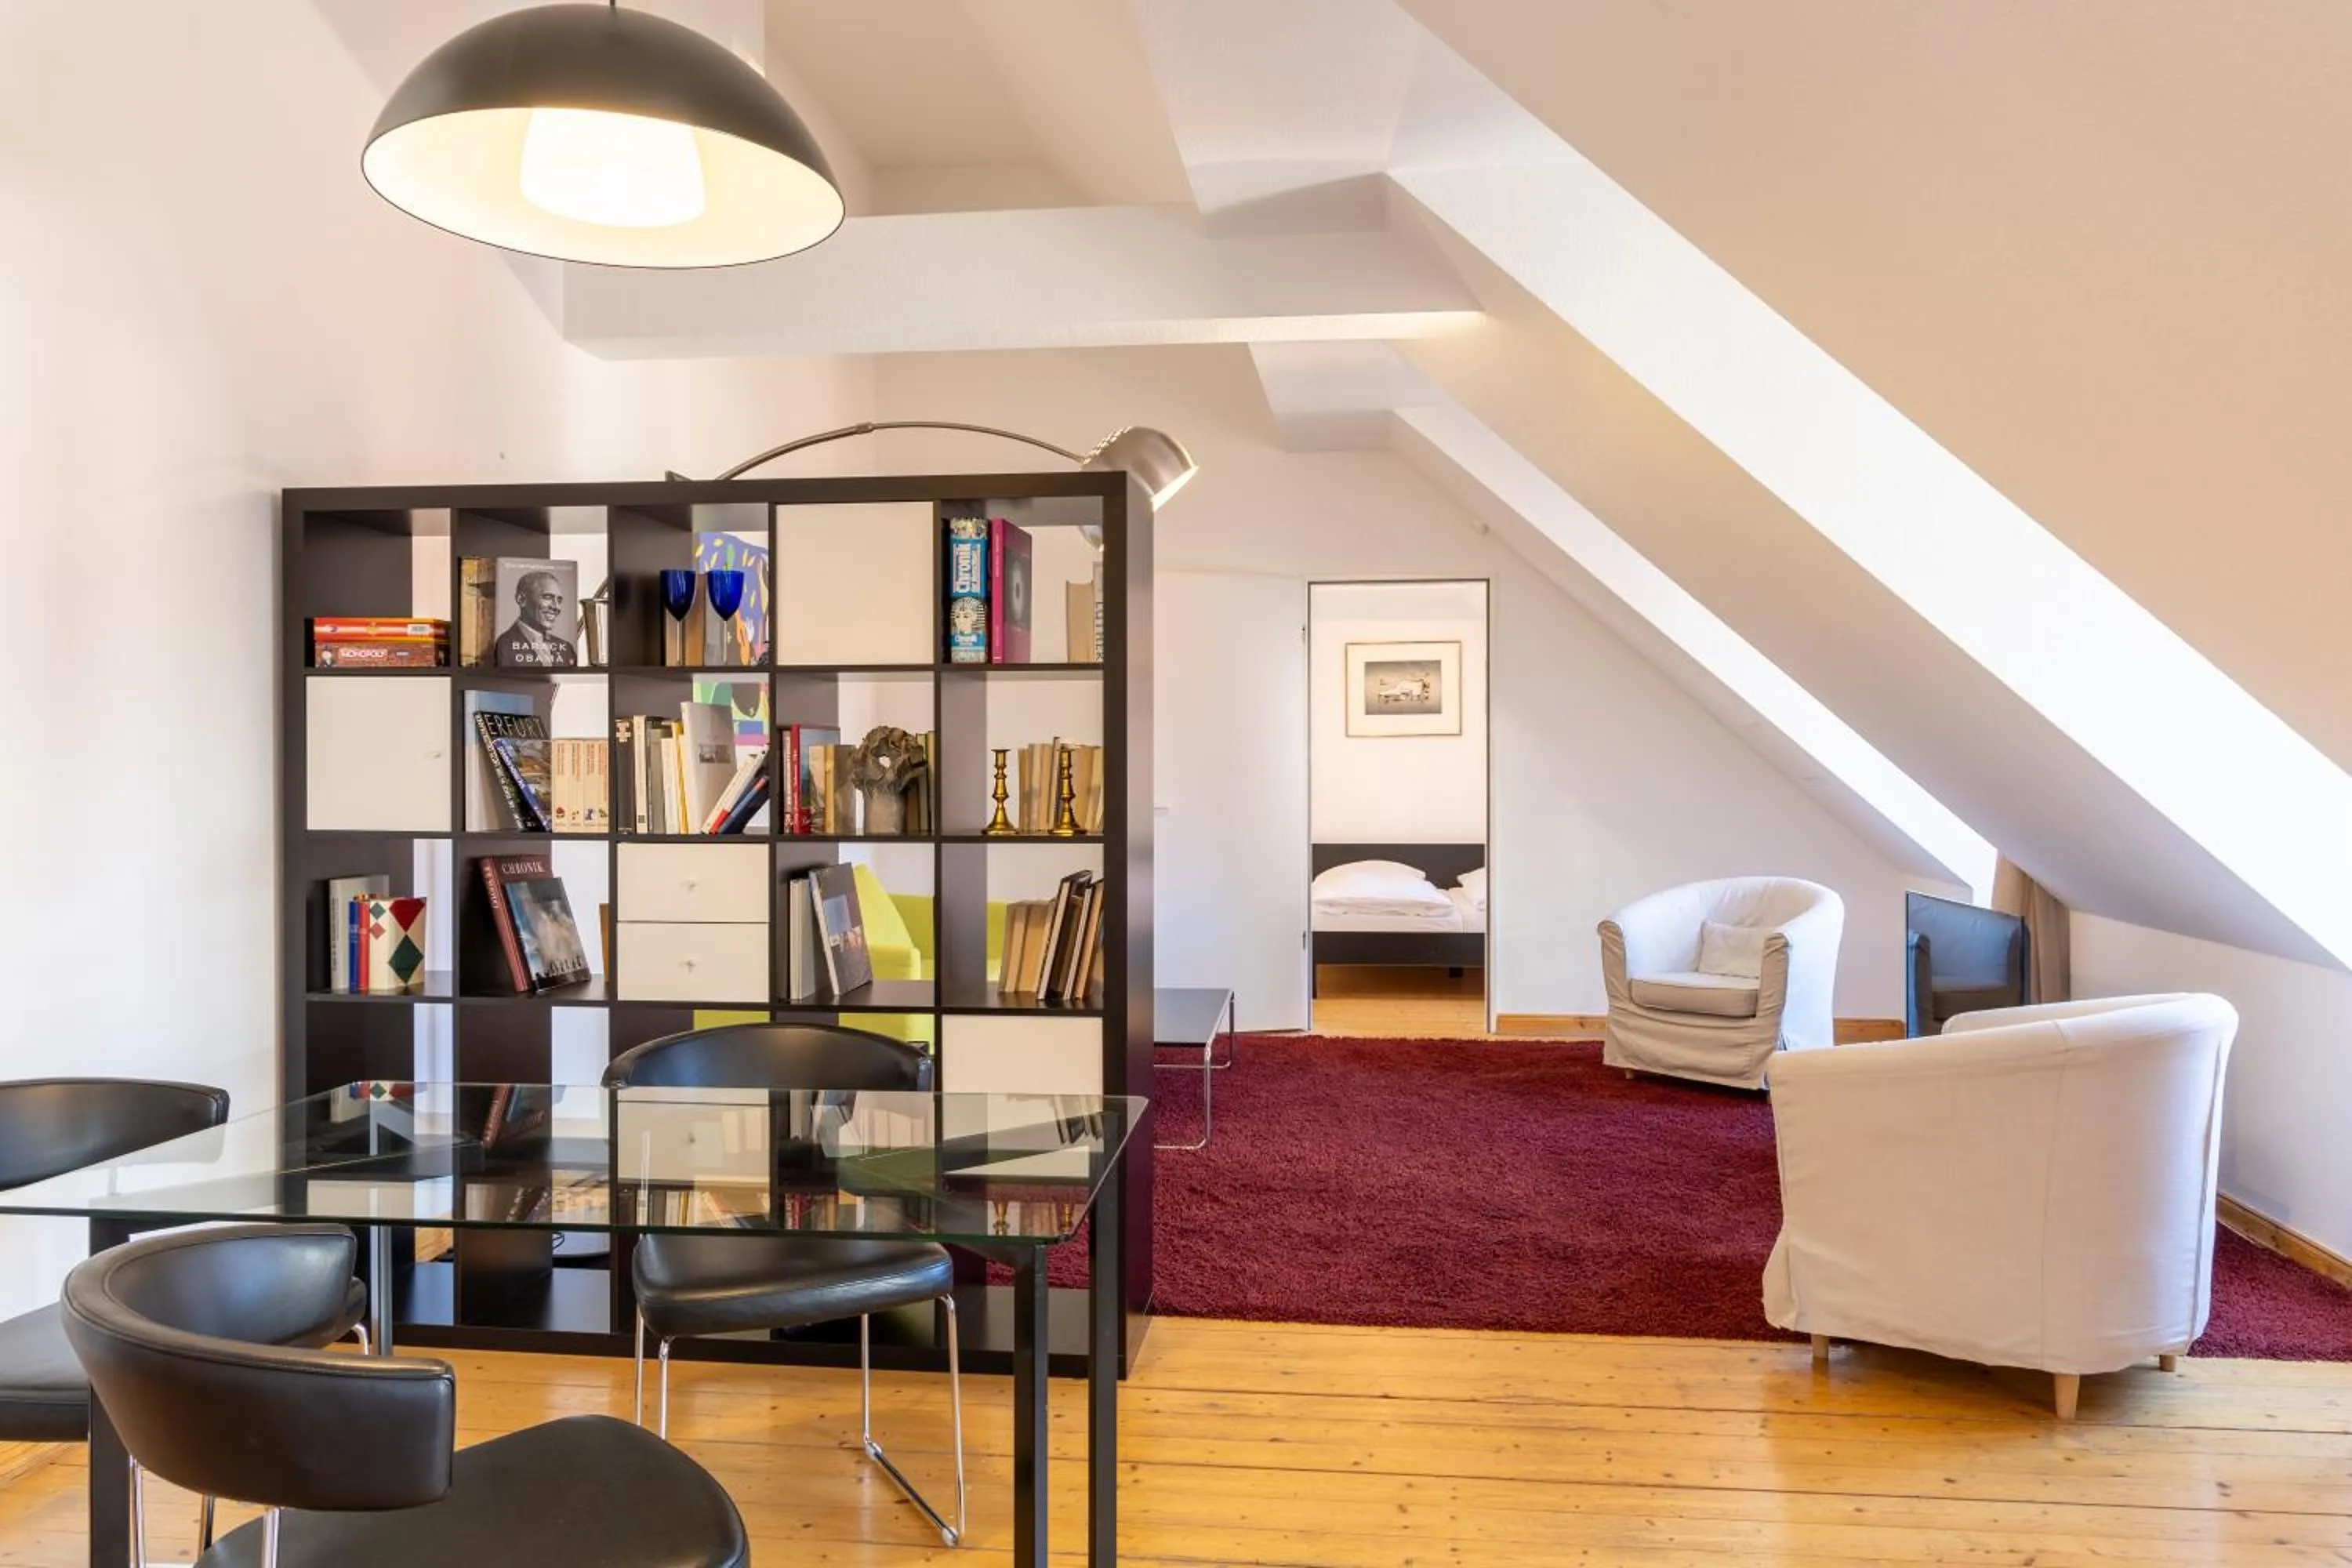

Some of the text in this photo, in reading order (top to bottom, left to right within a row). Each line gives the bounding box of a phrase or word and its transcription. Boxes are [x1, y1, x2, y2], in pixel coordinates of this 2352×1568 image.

[955, 544, 971, 593] Chronik
[512, 642, 567, 652] BARACK
[515, 654, 564, 662] OBAMA
[484, 714, 544, 738] ERFURT
[501, 861, 544, 874] CHRONIK
